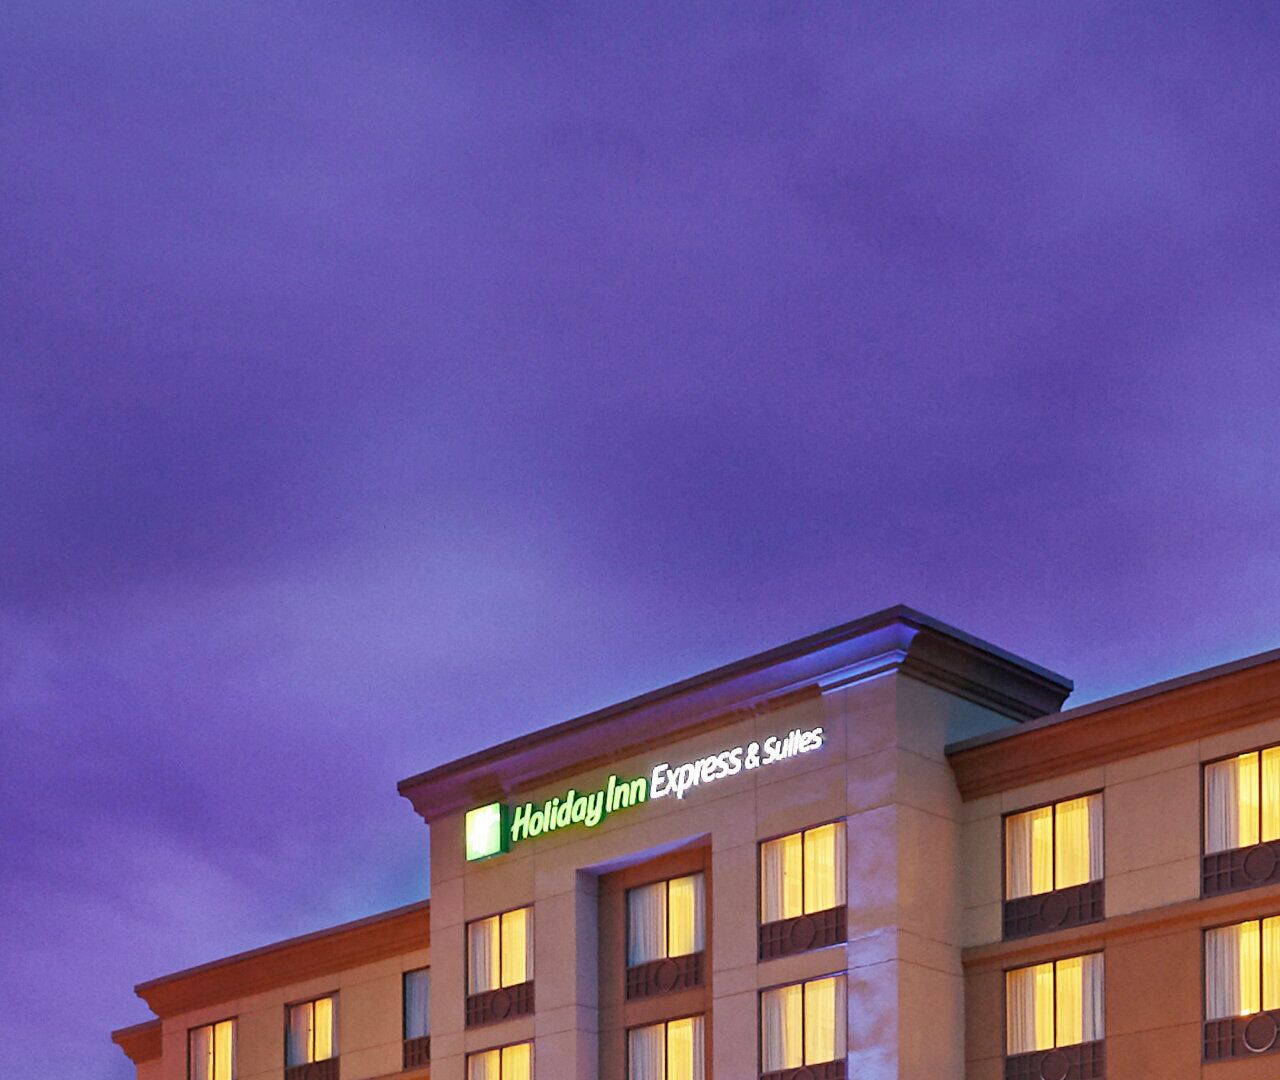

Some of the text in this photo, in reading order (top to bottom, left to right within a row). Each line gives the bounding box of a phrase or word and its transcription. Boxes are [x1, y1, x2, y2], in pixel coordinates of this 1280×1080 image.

[511, 728, 823, 841] Holiday Inn Express & Suites
